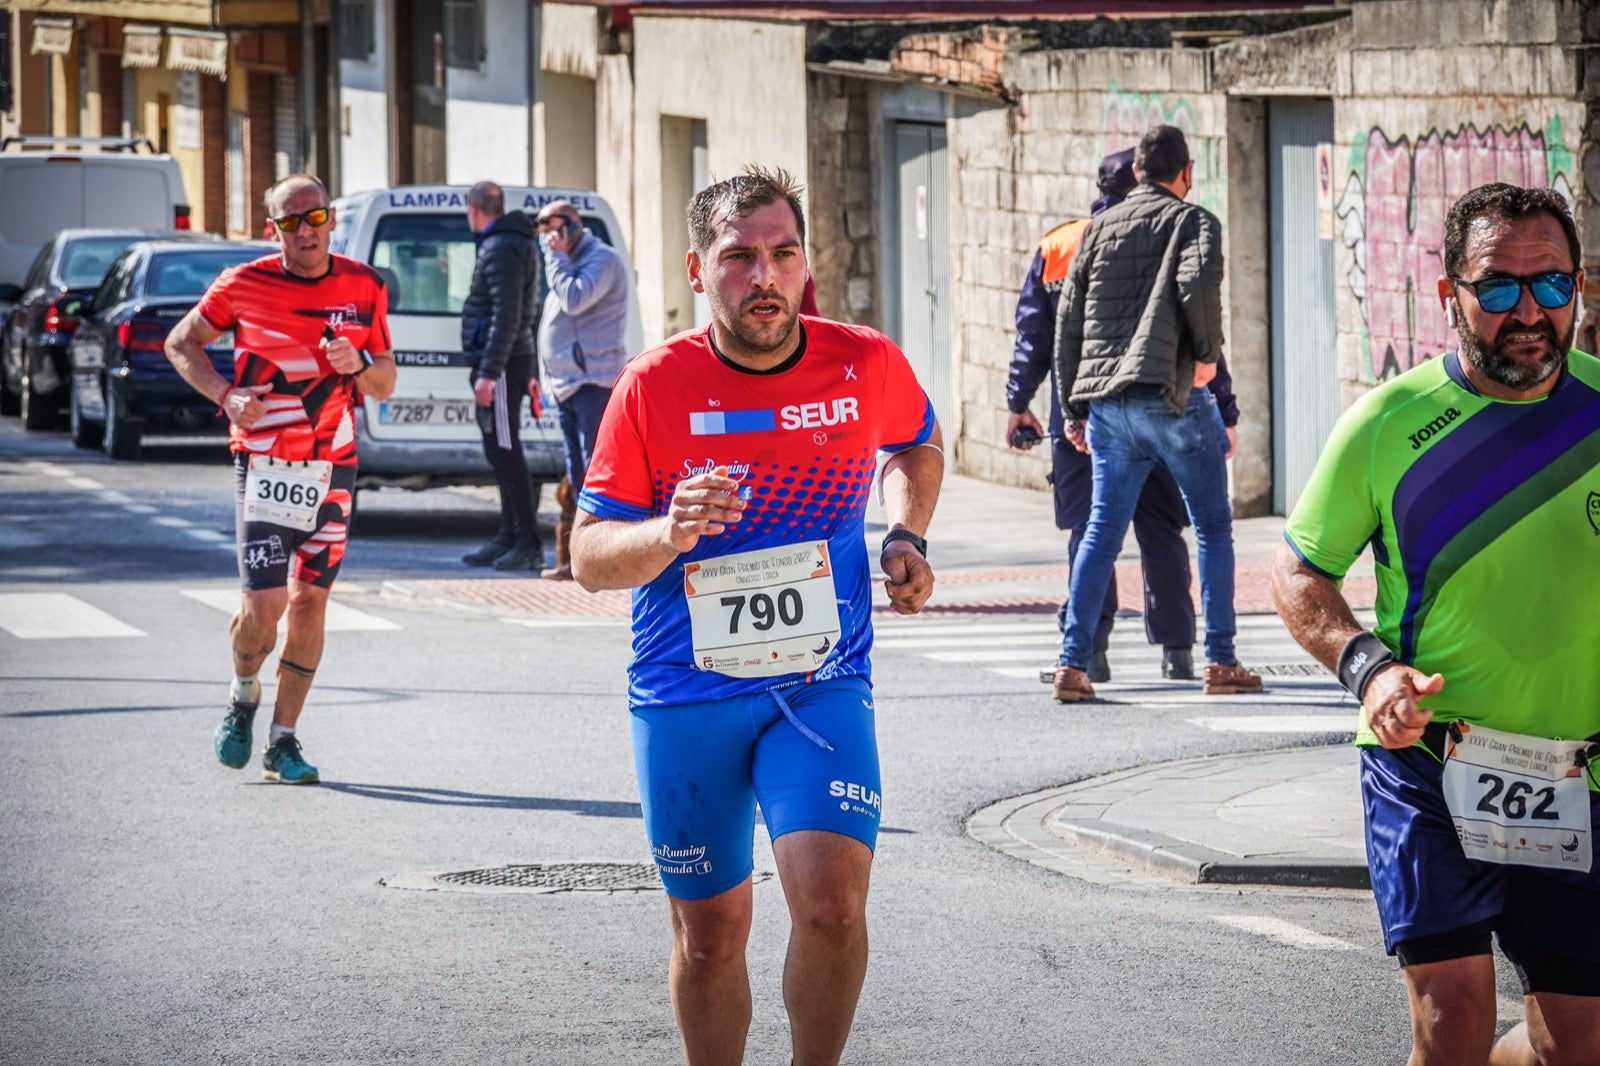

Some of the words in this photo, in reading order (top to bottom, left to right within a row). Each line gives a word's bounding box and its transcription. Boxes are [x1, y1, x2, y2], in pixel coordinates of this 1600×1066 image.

[390, 193, 468, 207] LAMPA
[396, 352, 449, 365] TROEN
[392, 404, 434, 423] 7287
[780, 397, 860, 431] SEUR
[1407, 407, 1462, 450] Joma
[257, 479, 319, 508] 3069
[793, 550, 812, 565] 2022
[720, 587, 804, 635] 790
[829, 780, 881, 813] SEUR
[1476, 773, 1560, 821] 262
[655, 863, 693, 874] ranada
